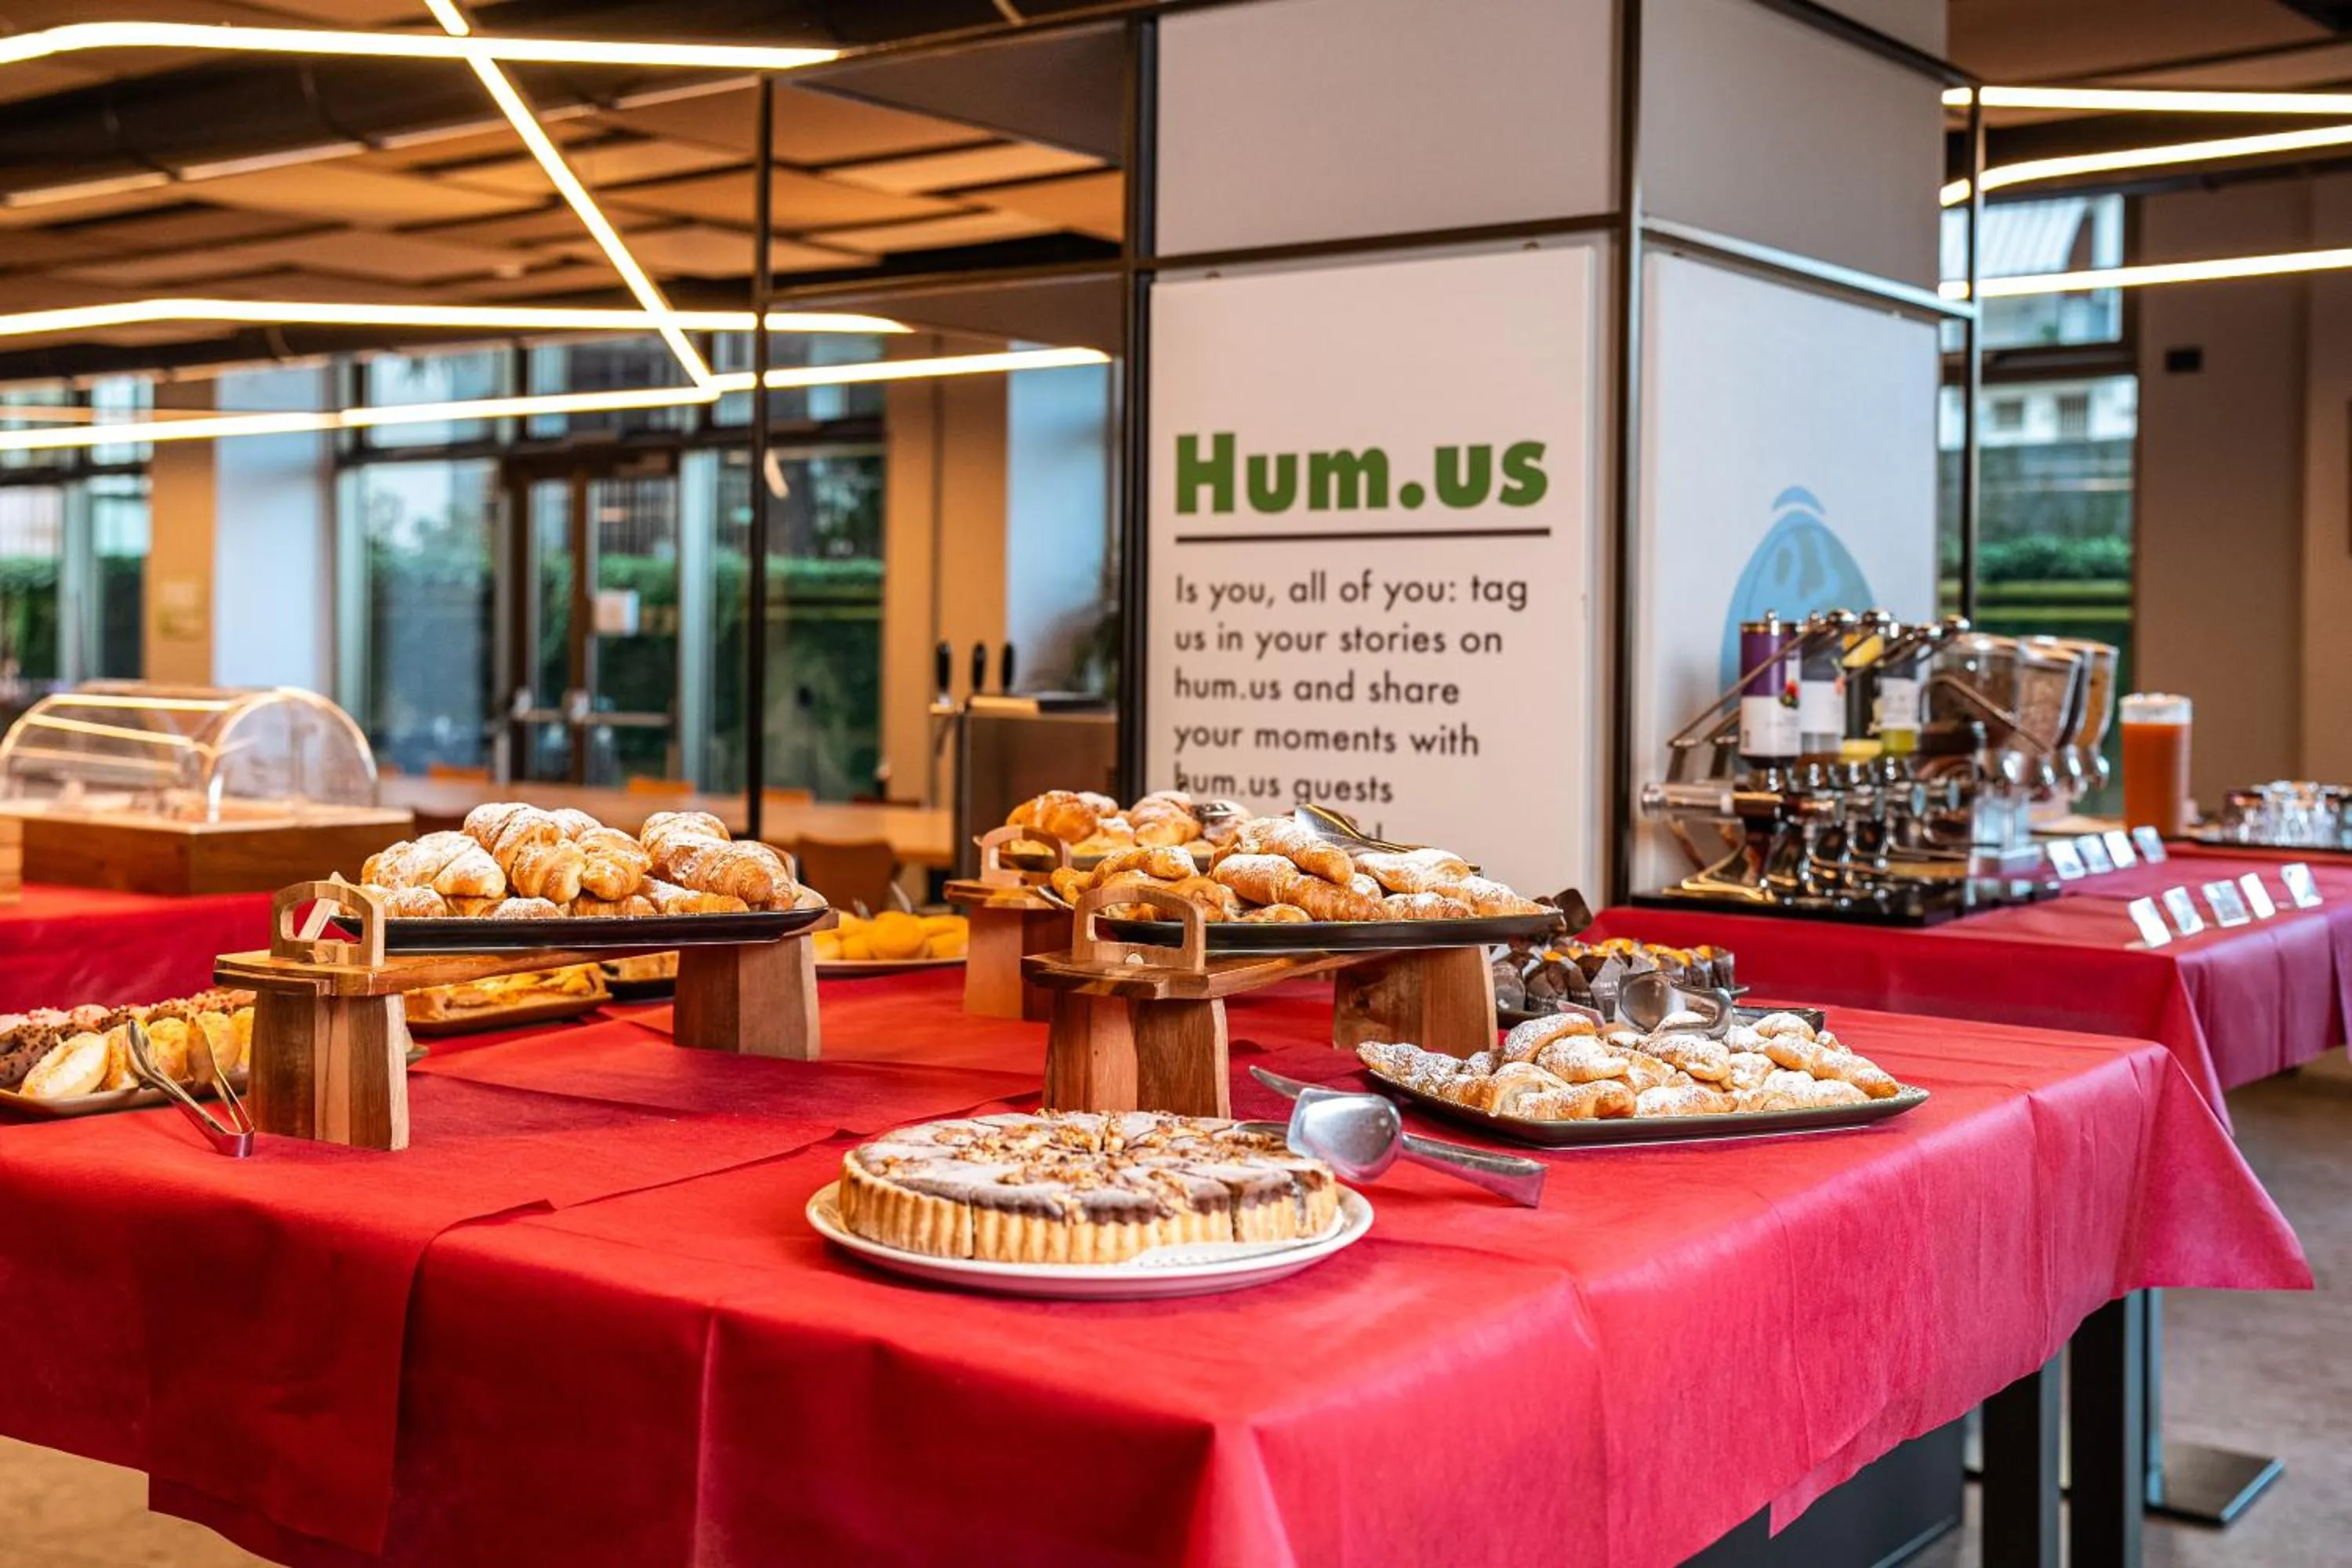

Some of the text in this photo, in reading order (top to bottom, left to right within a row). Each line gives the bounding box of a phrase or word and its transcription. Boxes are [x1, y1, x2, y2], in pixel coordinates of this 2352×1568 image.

[1175, 432, 1548, 515] Hum.us
[1176, 568, 1528, 612] Is you, all of you: tag
[1174, 622, 1503, 660] us in your stories on
[1174, 666, 1460, 705] hum.us and share
[1174, 722, 1479, 757] your moments with
[1174, 761, 1394, 804] hum.us guests
